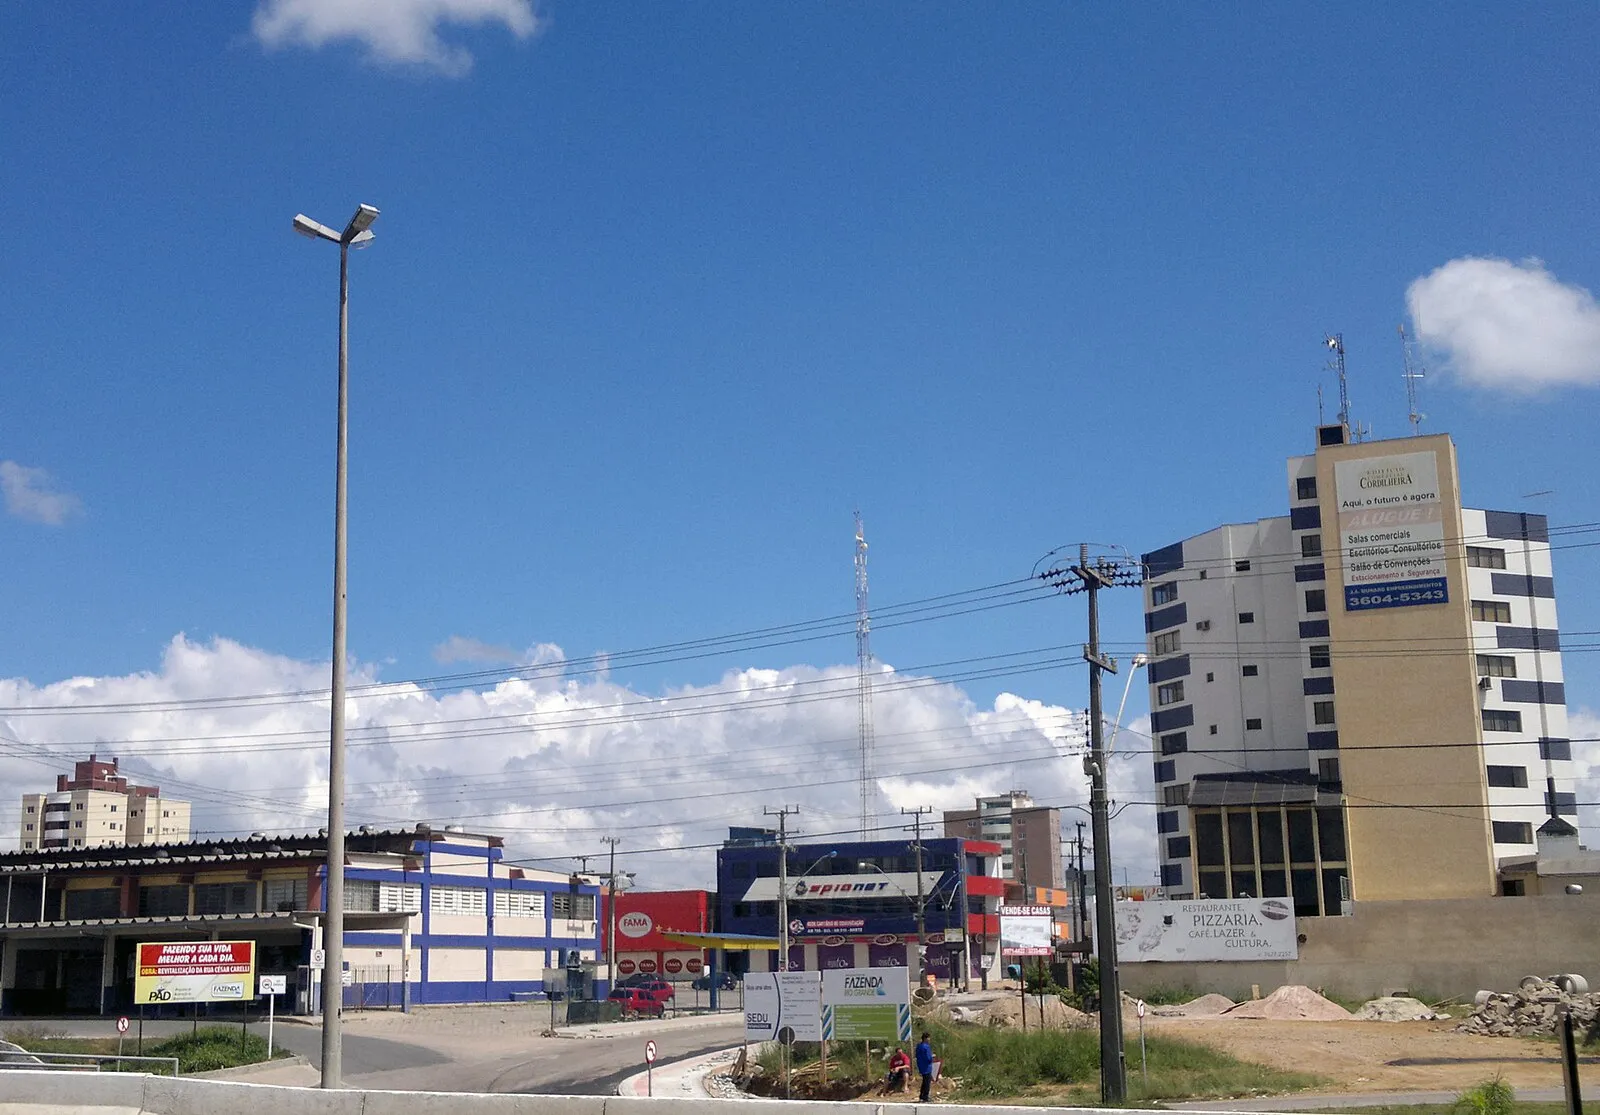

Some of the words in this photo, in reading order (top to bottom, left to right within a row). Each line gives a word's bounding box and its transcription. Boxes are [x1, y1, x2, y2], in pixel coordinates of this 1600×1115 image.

[1360, 473, 1413, 489] CORDILHEIRA
[1342, 499, 1364, 508] Aqui,
[1374, 495, 1400, 504] futuro
[1410, 492, 1435, 501] agora
[1348, 535, 1368, 544] Salas
[1370, 530, 1411, 541] comerciais
[1350, 562, 1371, 571] Salão
[1374, 562, 1382, 570] de
[1384, 557, 1431, 569] Convenções
[1351, 572, 1399, 582] Estacionamento
[1408, 568, 1440, 577] Segurança
[1350, 590, 1444, 606] 3604-5343
[1001, 906, 1030, 915] VENDE-SE
[1031, 906, 1050, 915] CASAS
[623, 918, 647, 927] FAMA
[162, 945, 196, 954] FAZENDO
[197, 945, 212, 953] SUA
[213, 944, 232, 953] VIDA
[157, 955, 190, 964] MELHOR
[190, 955, 197, 963] A
[198, 954, 218, 963] CADA
[219, 954, 235, 962] DIA.
[141, 967, 157, 975] OBRA:
[158, 965, 196, 975] REVITALIZAÇÃO
[845, 976, 883, 988] FAZENDA
[148, 991, 171, 1001] PAD
[213, 985, 241, 993] FAZENDA
[747, 1013, 768, 1023] SEDU
